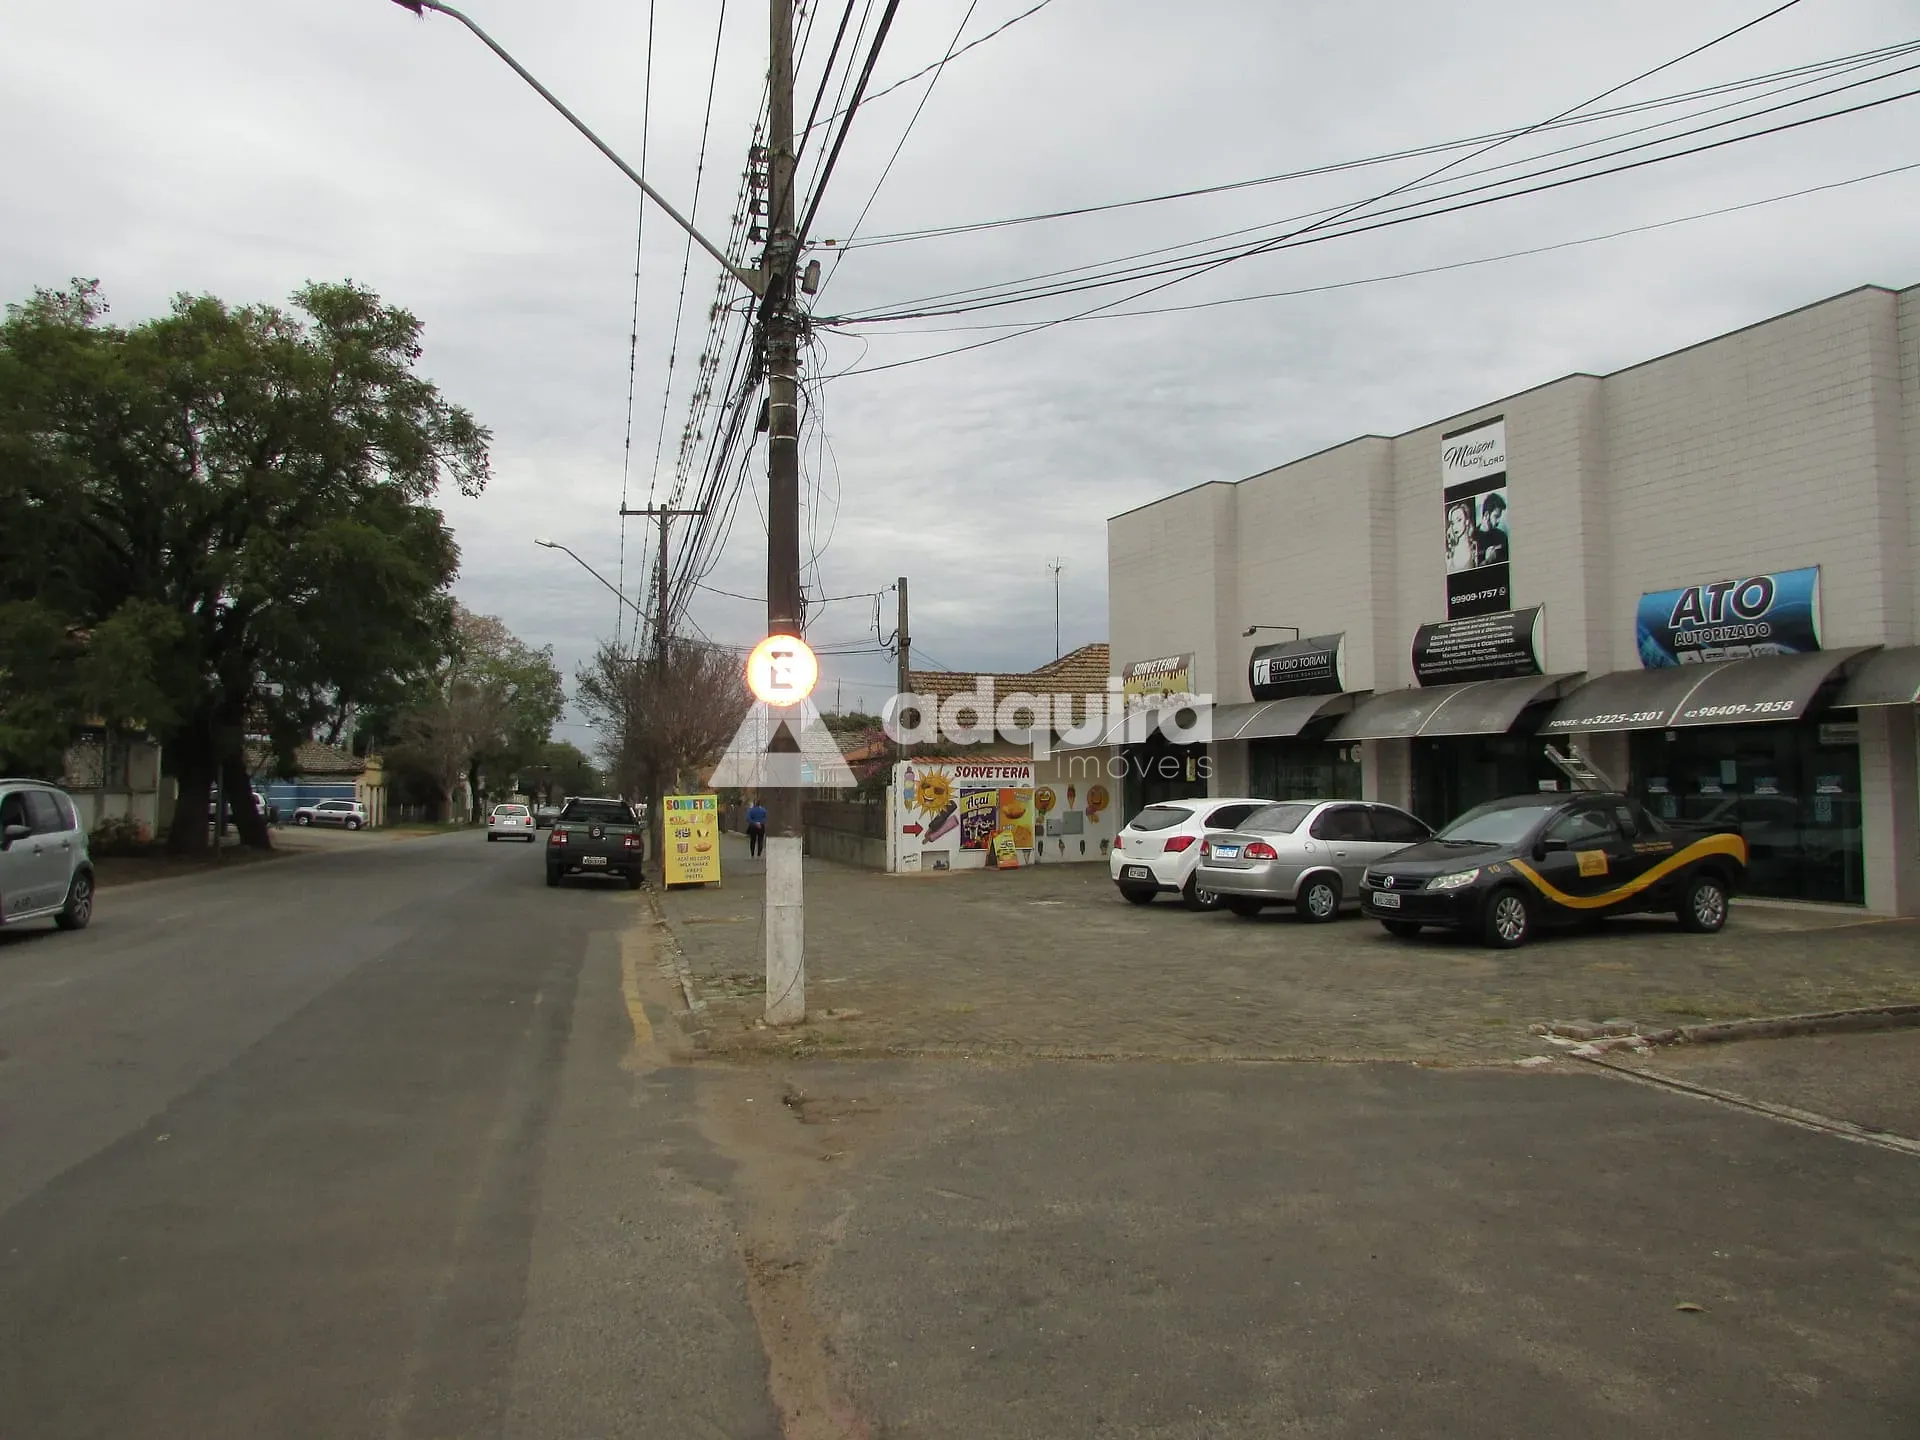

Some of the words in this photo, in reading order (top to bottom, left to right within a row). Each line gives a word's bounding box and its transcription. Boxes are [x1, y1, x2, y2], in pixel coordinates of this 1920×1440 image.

[1444, 440, 1495, 469] Maison
[1483, 455, 1505, 467] LORD
[1451, 588, 1498, 605] 99909-1757
[1668, 575, 1776, 628] ATO
[1674, 622, 1771, 646] AUTORIZADO
[1132, 656, 1180, 677] SORVETERIA
[1271, 659, 1298, 671] STUDIO
[1300, 655, 1327, 667] TORIAN
[1593, 710, 1664, 724] 3225-3301
[1699, 700, 1795, 718] 98409-7858
[954, 766, 1030, 779] SORVETERIA
